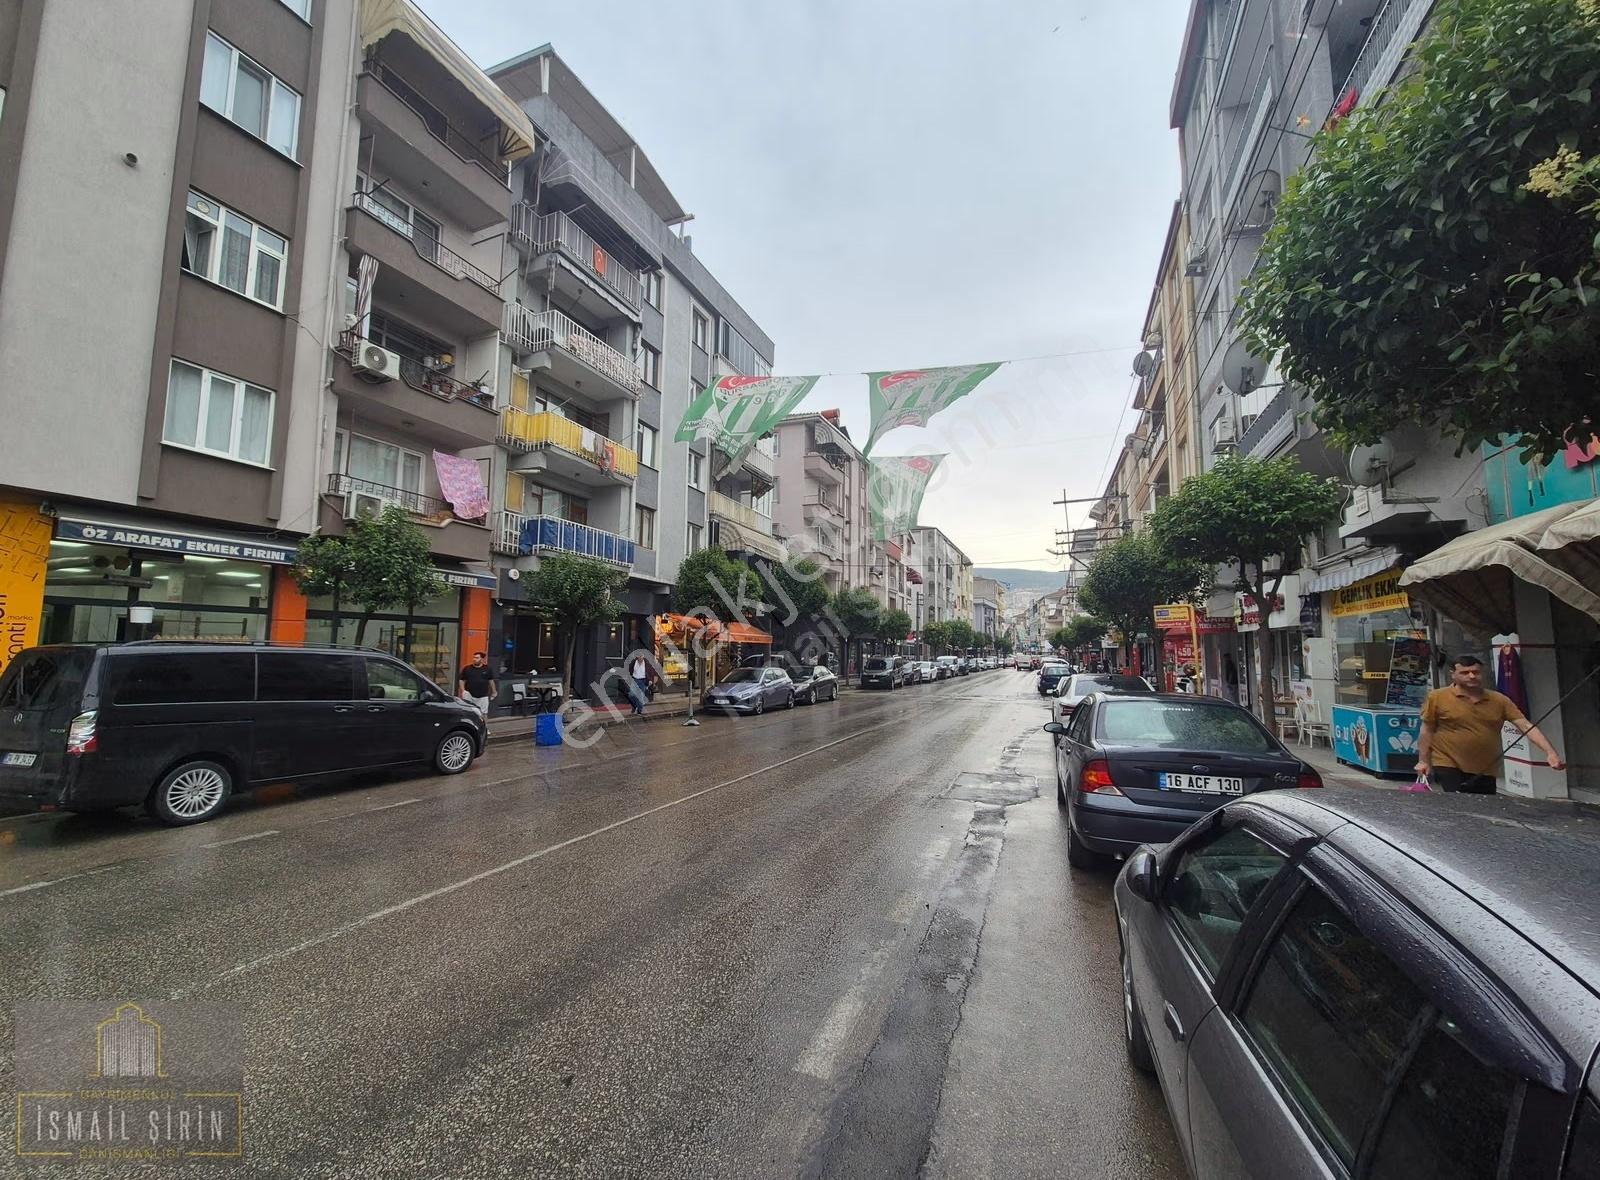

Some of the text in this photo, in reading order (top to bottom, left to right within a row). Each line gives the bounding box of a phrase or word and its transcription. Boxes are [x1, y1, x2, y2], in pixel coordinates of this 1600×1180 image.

[82, 525, 286, 561] ÖZ ARAFAT EKMEK FIRINI
[1167, 774, 1182, 787] 16
[1187, 776, 1211, 789] ACF
[1217, 778, 1240, 791] 130
